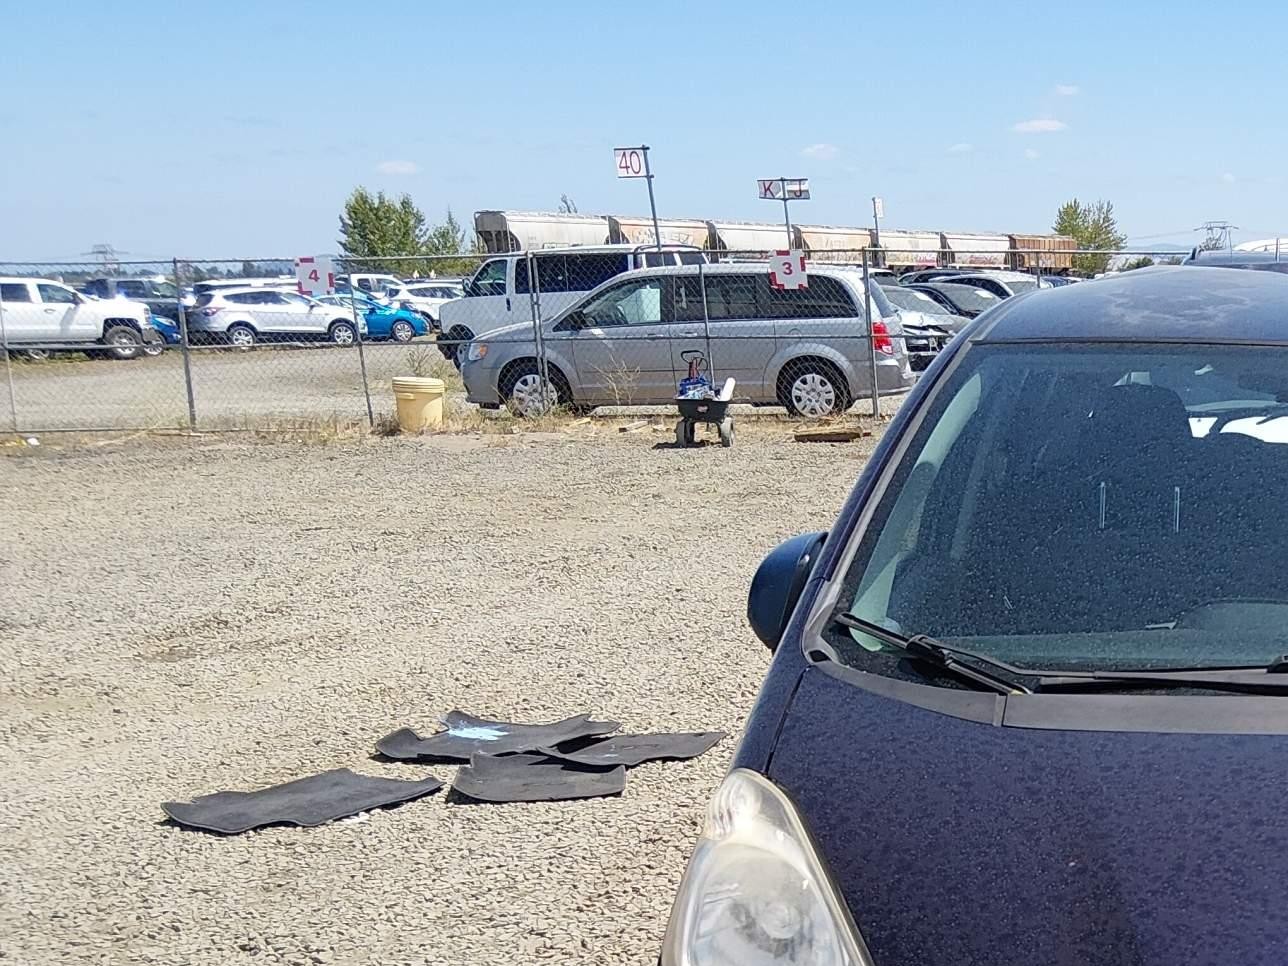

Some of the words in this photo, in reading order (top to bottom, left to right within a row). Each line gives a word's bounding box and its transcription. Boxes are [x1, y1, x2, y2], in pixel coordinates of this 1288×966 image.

[618, 150, 642, 175] 40
[762, 181, 776, 198] K
[308, 269, 321, 282] 4
[782, 261, 793, 276] 3
